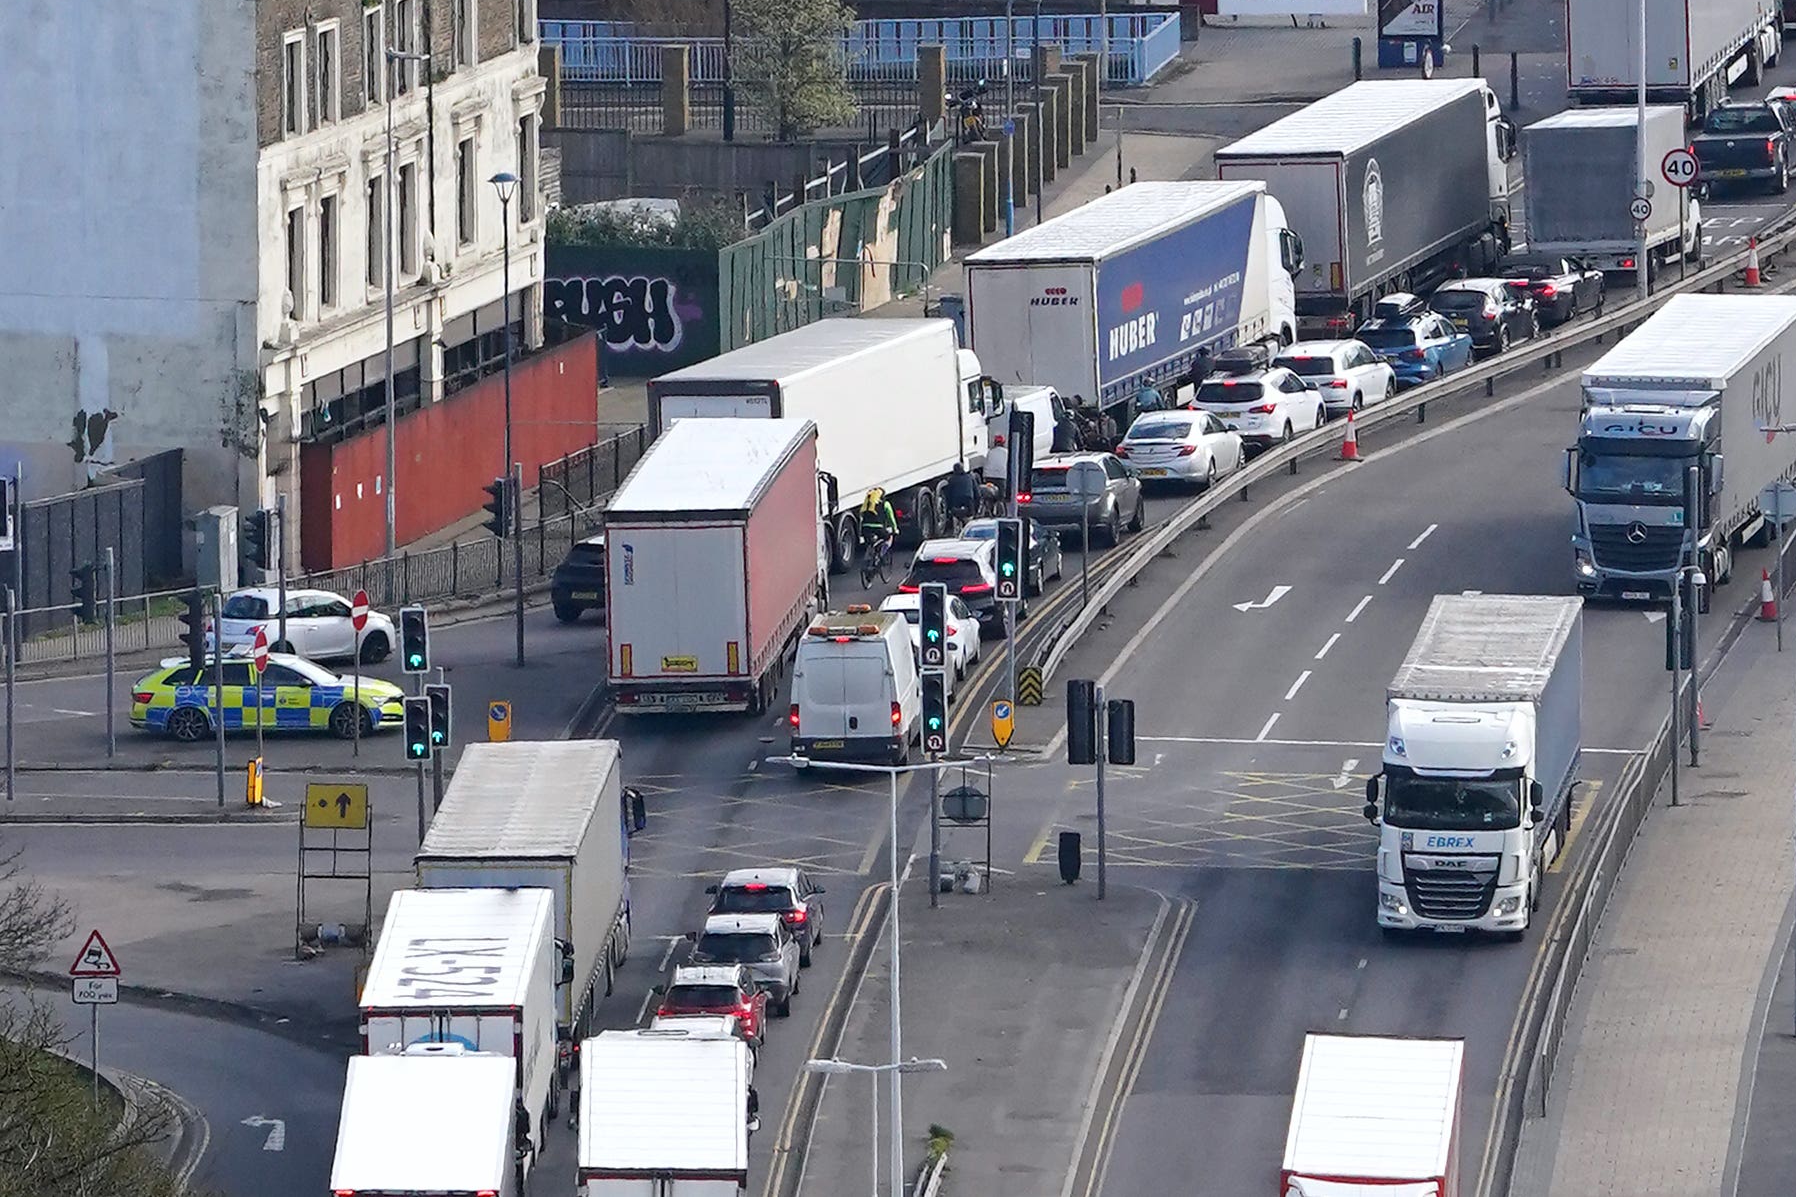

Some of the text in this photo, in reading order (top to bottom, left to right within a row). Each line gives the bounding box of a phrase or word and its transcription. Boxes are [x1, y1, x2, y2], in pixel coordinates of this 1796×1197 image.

[1412, 4, 1434, 14] AIR
[1667, 160, 1694, 175] 40
[1632, 204, 1648, 215] 40
[1030, 297, 1078, 306] HUBER
[1109, 311, 1156, 361] HUBER
[1426, 836, 1475, 848] EBREX
